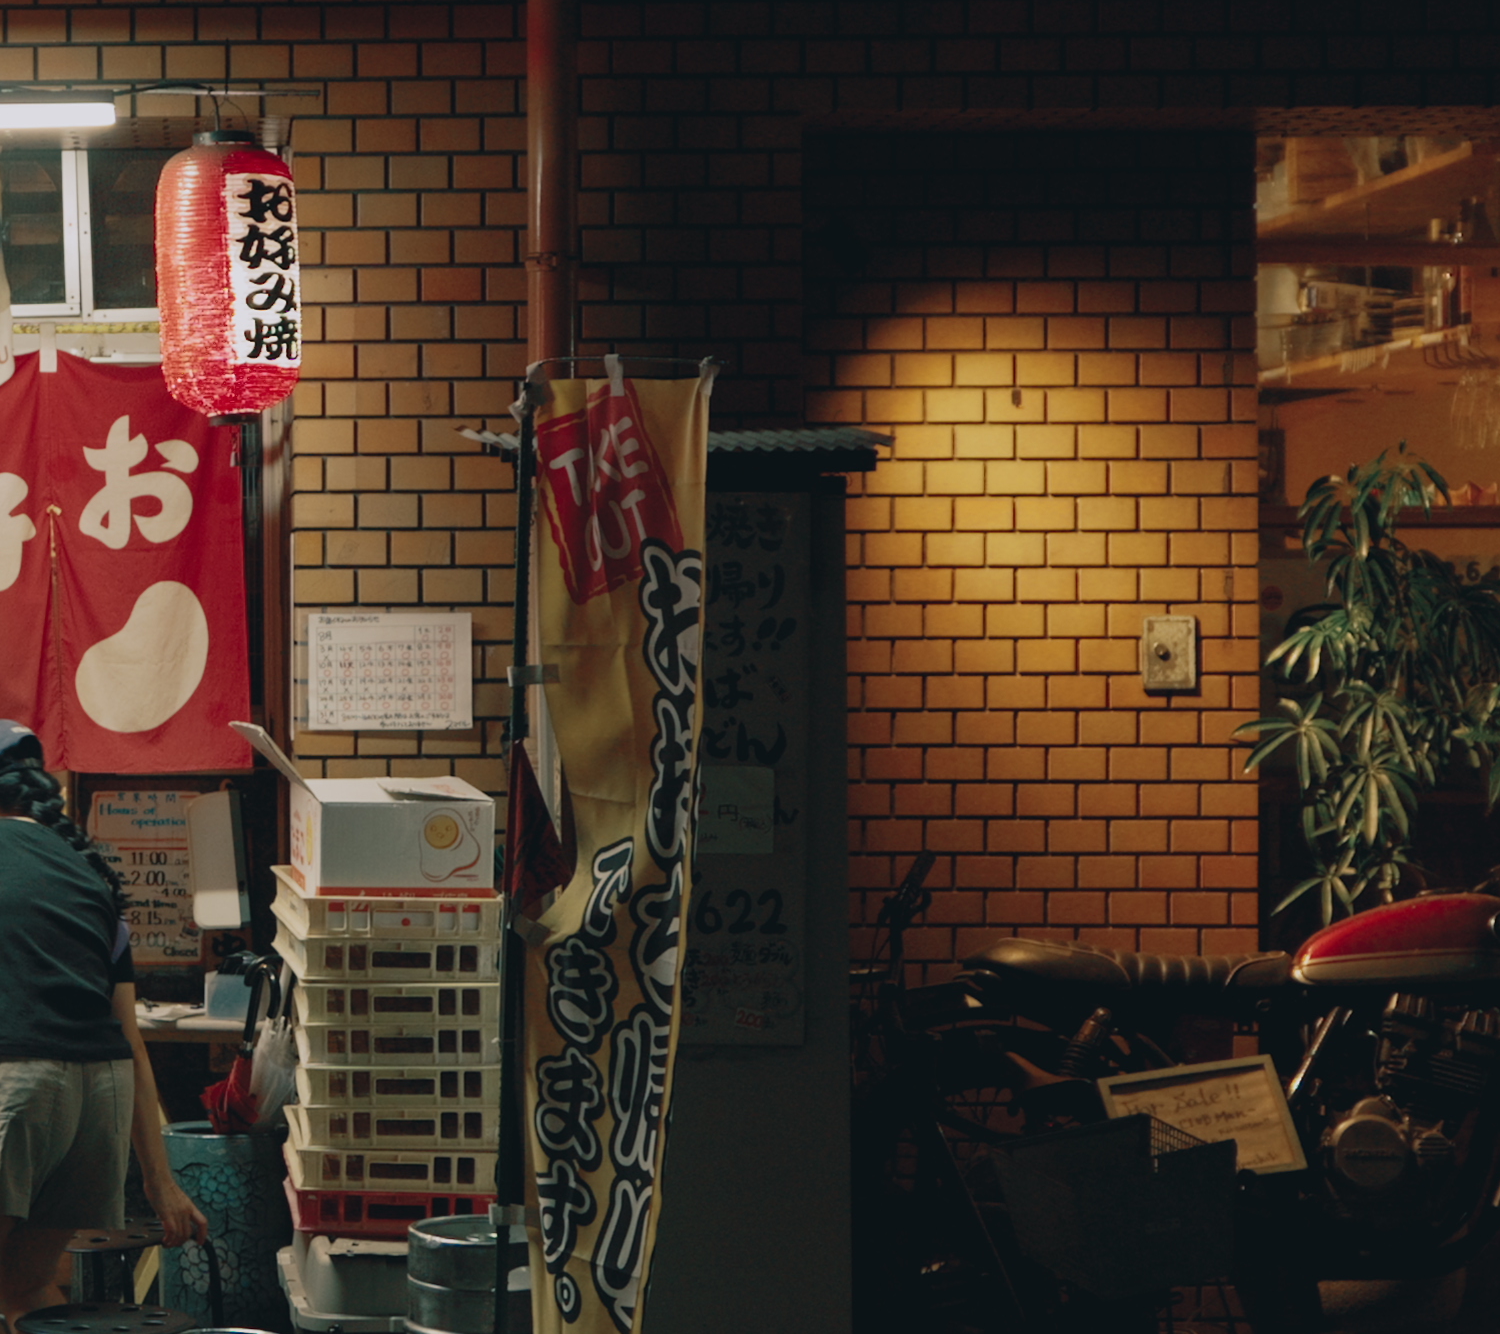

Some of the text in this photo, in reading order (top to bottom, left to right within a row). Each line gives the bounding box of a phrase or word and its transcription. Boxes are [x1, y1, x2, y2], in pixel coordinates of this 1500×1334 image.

[236, 178, 299, 362] お好み焼
[549, 416, 649, 506] TKE
[131, 817, 187, 830] operatio
